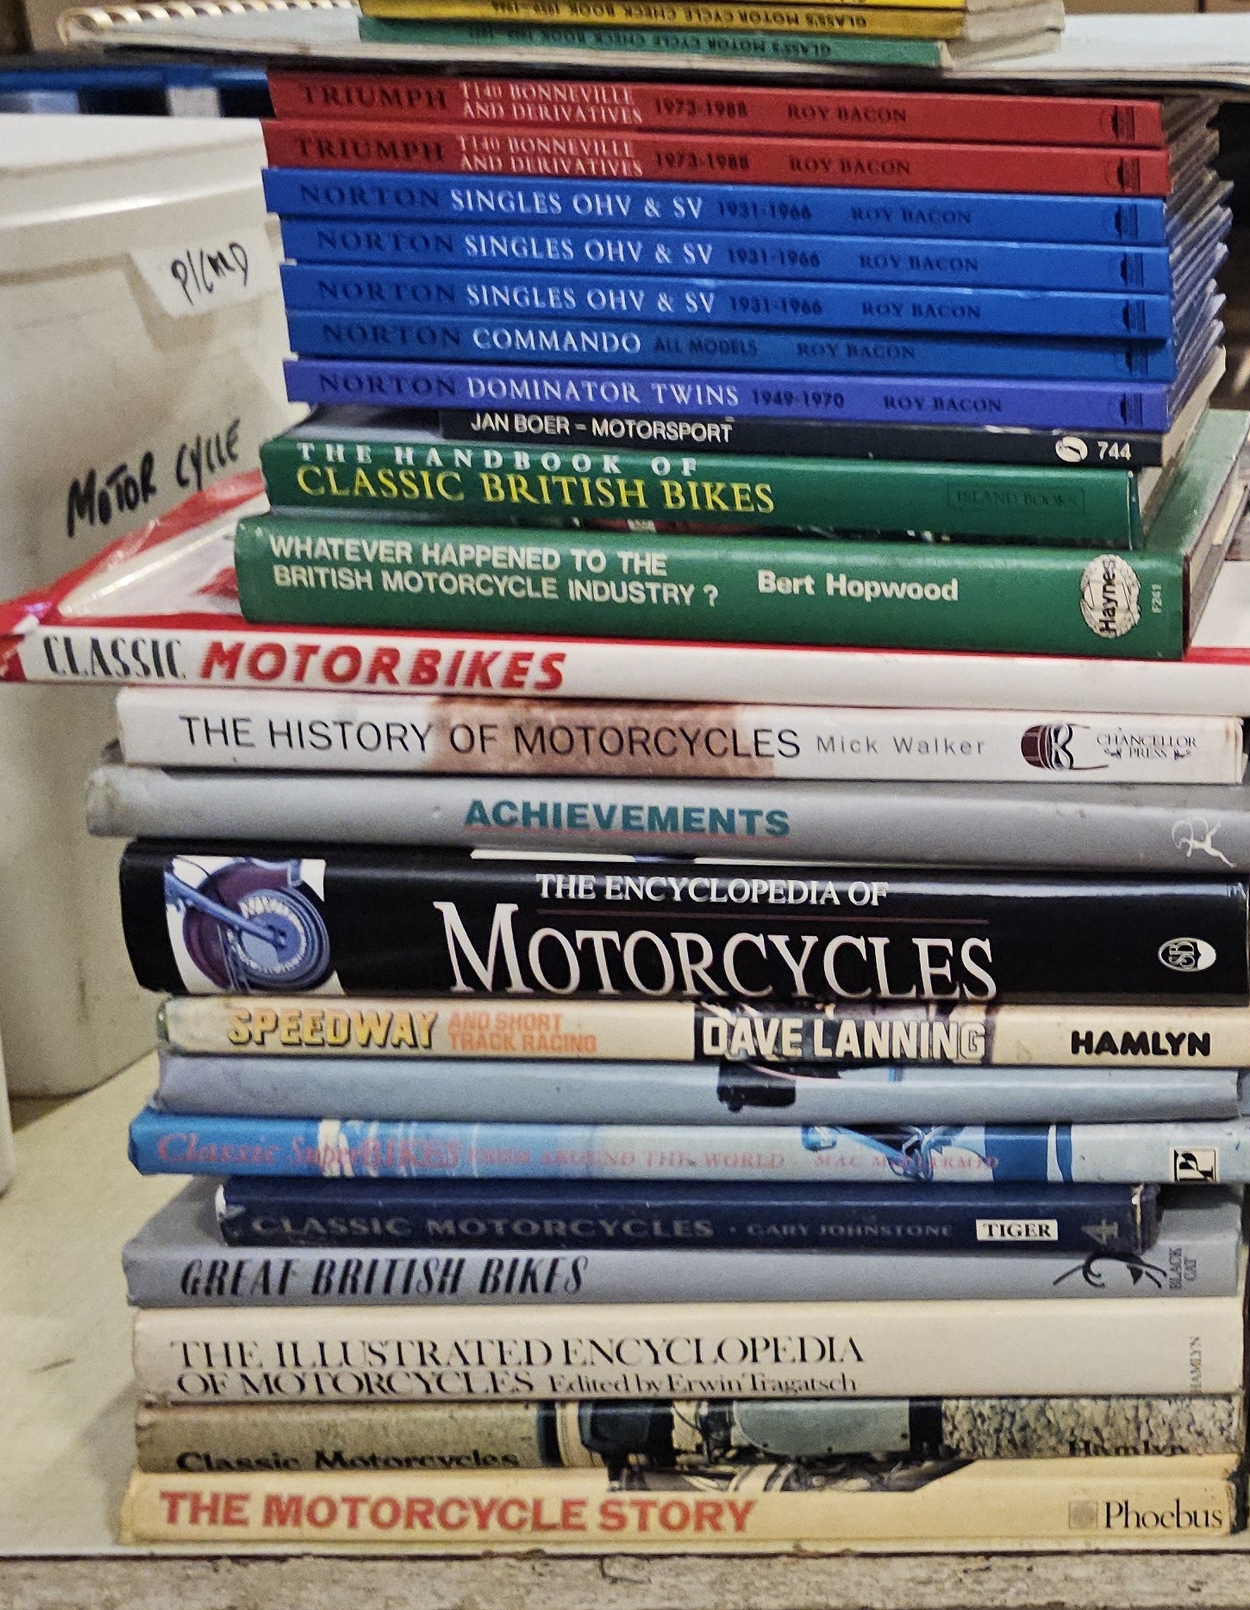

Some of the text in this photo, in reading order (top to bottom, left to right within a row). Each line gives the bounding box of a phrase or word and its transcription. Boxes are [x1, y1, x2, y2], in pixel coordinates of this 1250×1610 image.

[302, 85, 447, 109] TRIUMPH
[463, 103, 643, 125] AND DERIVATIVES
[787, 104, 907, 124] ROY BACON
[450, 189, 972, 226] SINGLES OHV SV ROY BACON
[319, 372, 1002, 413] NORTON DOMINATOR TWINS ROY BACON
[471, 412, 1132, 460] JAN BOER MOTORSPORT 744
[297, 465, 775, 514] CLASSIC BRITISH BIKES
[268, 535, 667, 577] WHATEVER HAPPENED TO THE
[273, 565, 695, 606] BRITISH MOTORCYCLE INDUSTRY
[757, 569, 960, 603] Bert Hopwood
[1098, 560, 1117, 633] Haynes
[42, 634, 566, 691] CLASSIC MOTORBIKES
[179, 714, 986, 759] THE HISTORY OF MOTORCYCLES Mick Walker
[1096, 732, 1198, 749] CHANCELLOR
[464, 798, 790, 836] ACHIEVEMENTS
[535, 873, 889, 907] THE ENCYCLOPEDIA OF
[433, 901, 997, 999] MOTORCYCLES
[227, 1008, 437, 1050] SPEEDWAY
[703, 1018, 1211, 1063] DAVE LANNING HAMLYN
[983, 1222, 1051, 1239] TIGER
[180, 1255, 589, 1296] GREAT BRITISH BIKES
[171, 1336, 865, 1368] THE ILLUSTRATED ENCYCLOPEDIA
[177, 1371, 632, 1398] OF MOTORCYCLES Edited
[160, 1491, 1223, 1533] THE MOTORCYCLE STORY Phoebus
